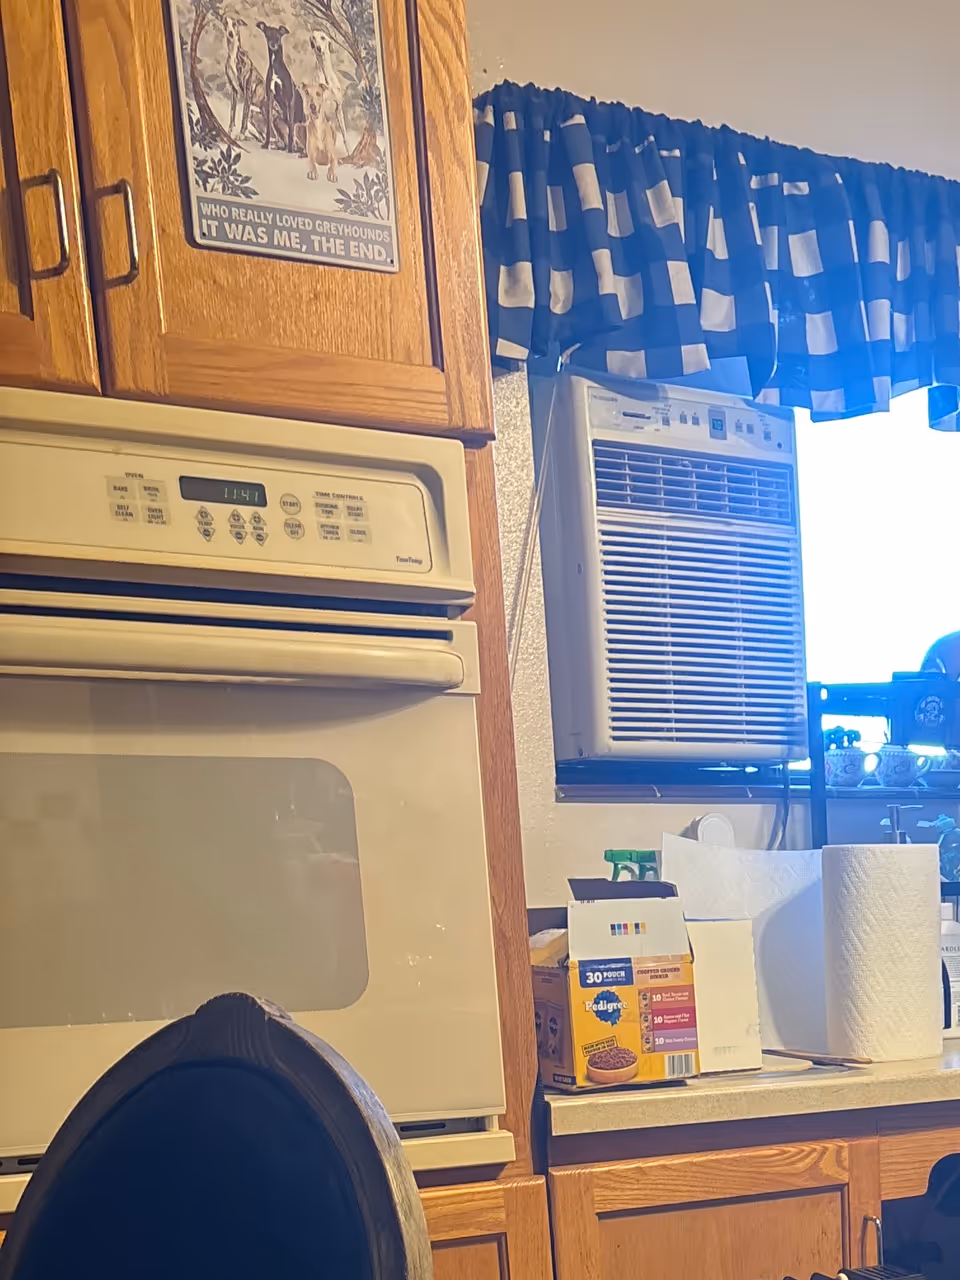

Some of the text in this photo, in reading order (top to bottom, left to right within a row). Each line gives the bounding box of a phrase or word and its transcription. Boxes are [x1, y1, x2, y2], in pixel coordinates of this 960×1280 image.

[200, 202, 391, 242] WHO REALLY LOVED GREYHOUNDS
[201, 219, 394, 263] IT WAS ME, THE END.
[586, 970, 626, 984] 30 POUCH
[652, 993, 662, 1002] 10
[585, 1000, 628, 1012] Pedigree
[653, 1015, 663, 1024] 10
[655, 1037, 665, 1045] 10
